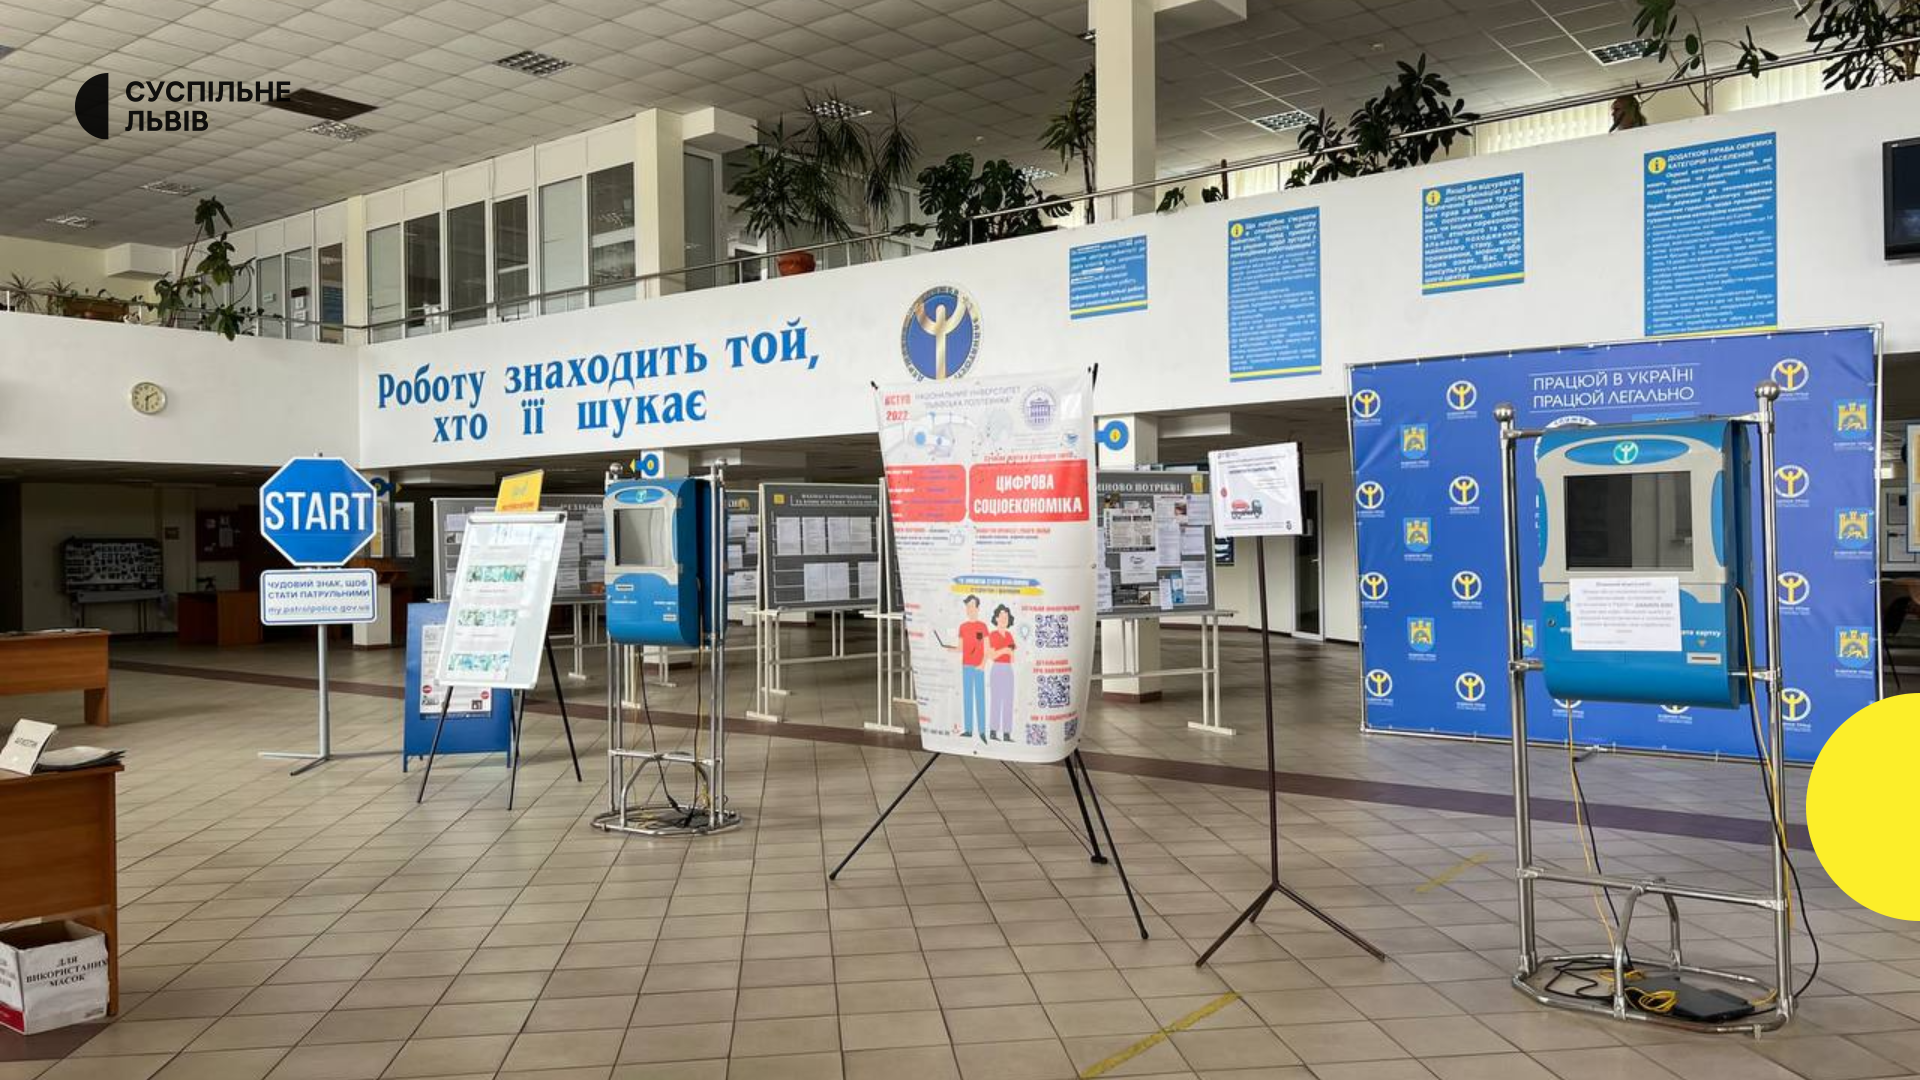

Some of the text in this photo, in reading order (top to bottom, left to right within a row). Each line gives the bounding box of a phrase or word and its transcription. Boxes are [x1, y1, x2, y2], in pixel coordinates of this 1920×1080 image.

[1710, 146, 1734, 155] ПРАВА
[1736, 139, 1772, 149] ОКРЕМИХ
[378, 317, 819, 409] Роботу знаходить той,
[1534, 368, 1693, 390] ПРАЦЮЙ В УКРАЇНІ
[884, 393, 911, 406] ВСТУП
[1534, 387, 1694, 408] ПРАЦЮЙ ЛЕГАЛЬНО
[432, 389, 707, 443] хто її шукає
[886, 410, 908, 421] 2022
[996, 475, 1054, 493] ЦИФРОВА
[265, 492, 371, 530] START
[974, 497, 1082, 516] СОЦІОЕКОНОМІКА
[268, 581, 313, 589] ЧУДОВИЙ
[345, 579, 367, 587] ЩОБ
[300, 590, 369, 598] ПАТРУЛЬНИМИ
[57, 956, 78, 967] ДЛЯ
[26, 959, 107, 983] ВИКОРИСТАНИХ
[49, 973, 86, 986] МАСОК
